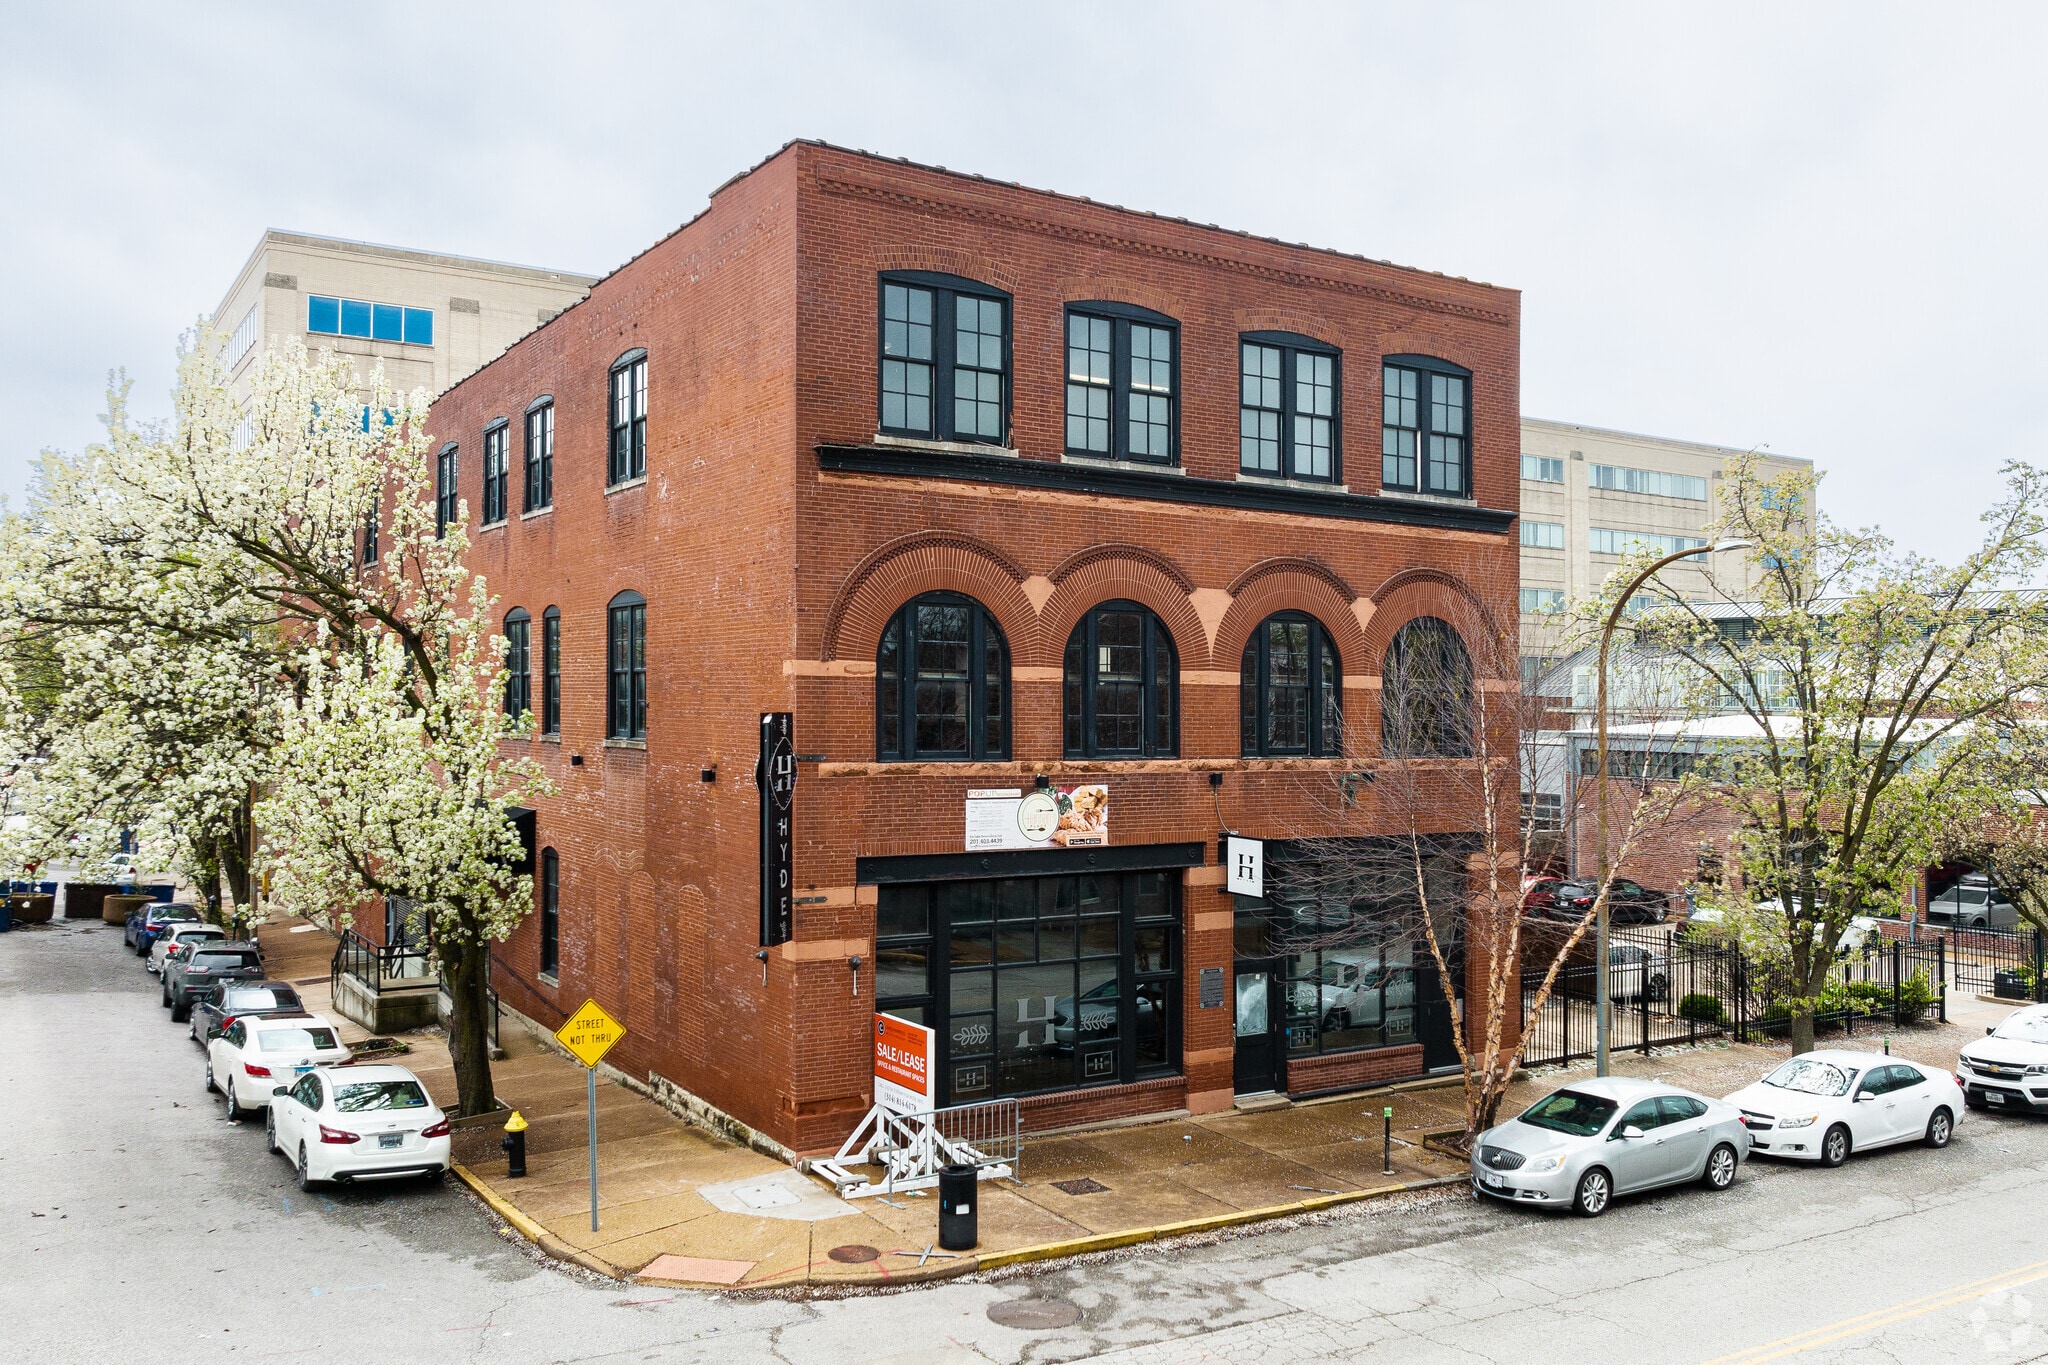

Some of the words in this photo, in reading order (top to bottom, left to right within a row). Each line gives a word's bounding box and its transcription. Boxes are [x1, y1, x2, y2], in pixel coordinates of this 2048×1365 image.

[1238, 854, 1254, 879] H
[576, 1019, 604, 1030] STREET
[1015, 995, 1058, 1048] H
[570, 1035, 585, 1046] NOT
[591, 1033, 611, 1044] THRU
[877, 1041, 925, 1073] SALE/LEASE
